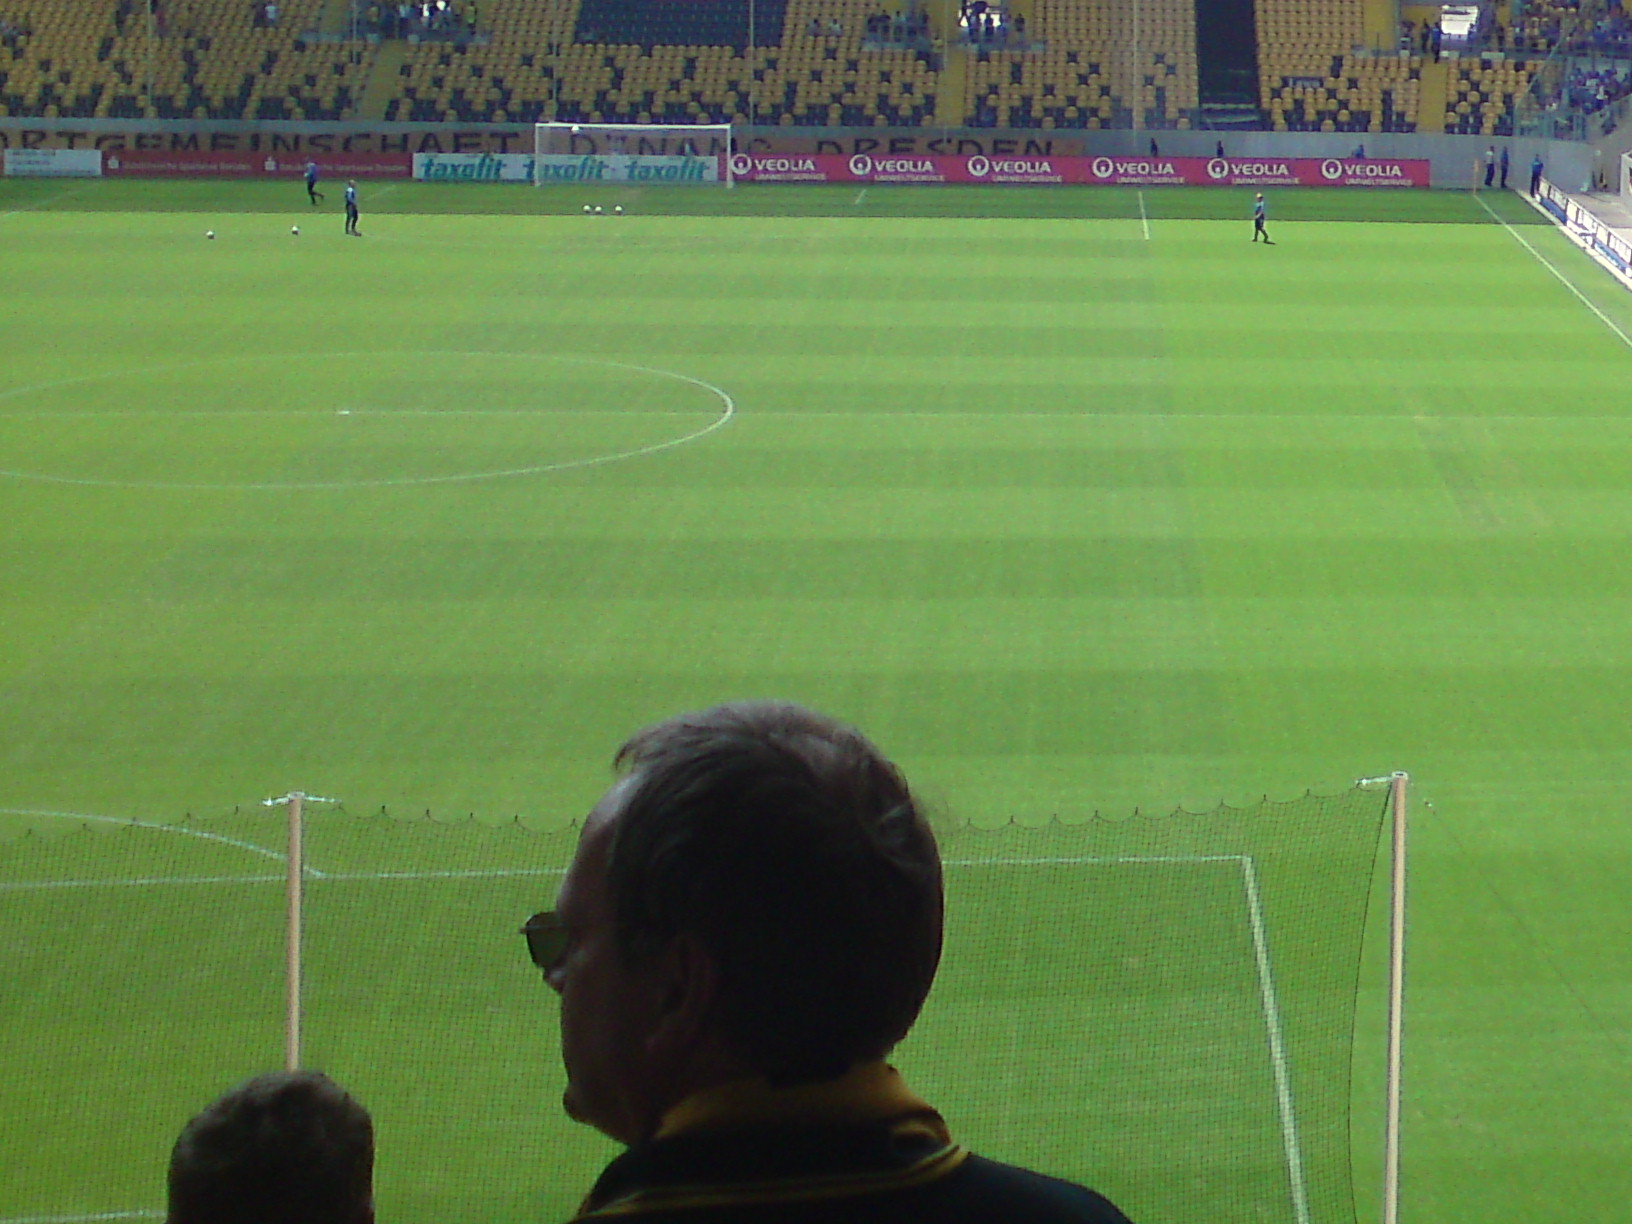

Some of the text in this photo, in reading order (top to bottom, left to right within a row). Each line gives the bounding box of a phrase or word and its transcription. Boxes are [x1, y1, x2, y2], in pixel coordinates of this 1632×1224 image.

[755, 158, 815, 172] VEOLIA
[875, 160, 934, 173] VEOLIA
[992, 160, 1051, 174] VEOLIA
[1116, 162, 1175, 175] VEOLIA
[1232, 163, 1289, 176] VEOLIA
[1345, 164, 1402, 177] VEOLIA
